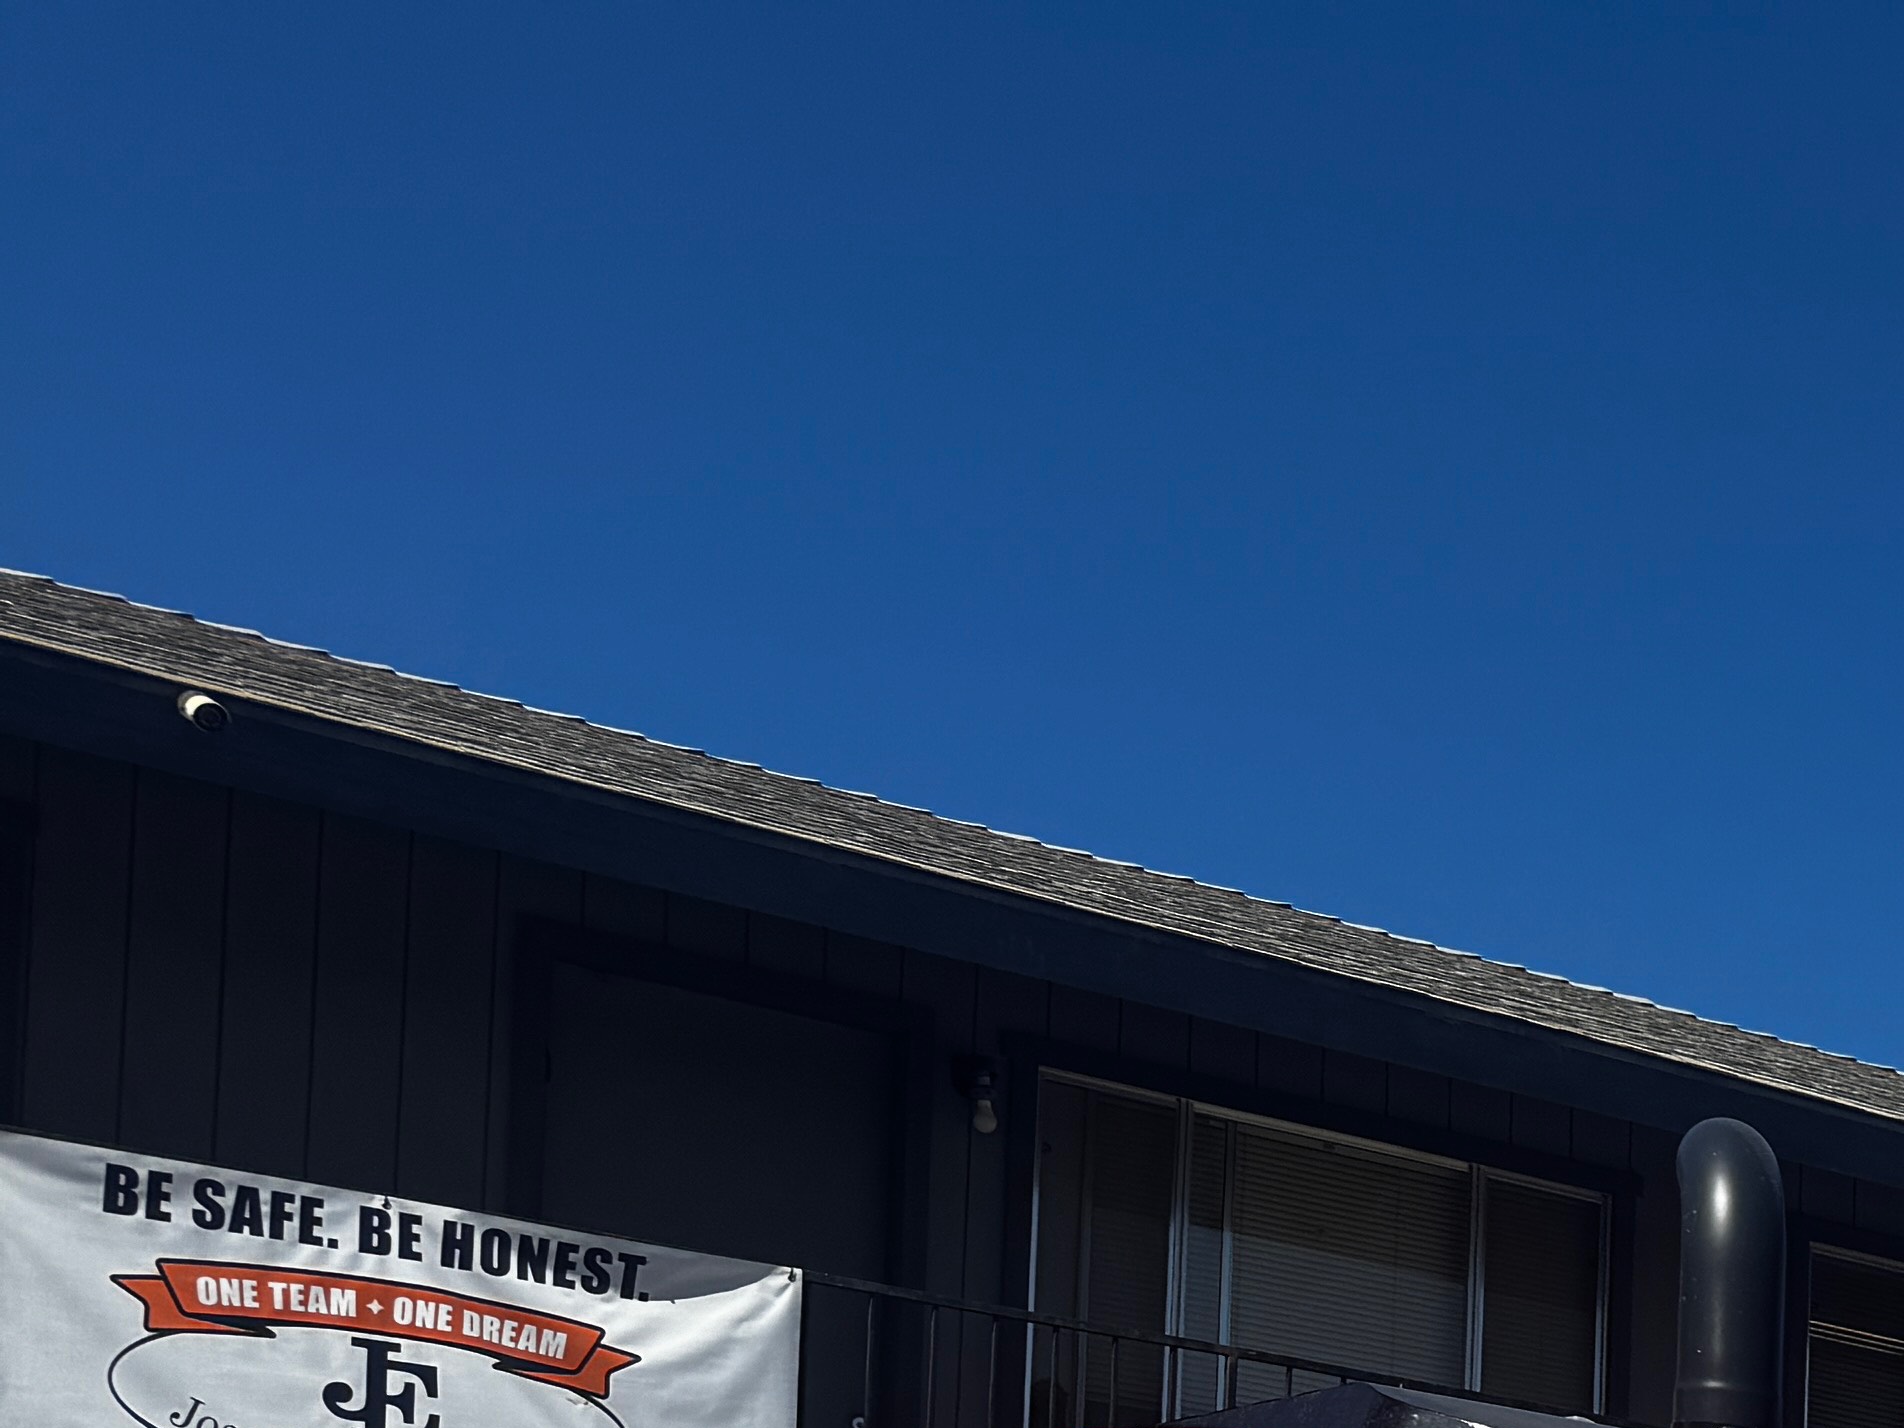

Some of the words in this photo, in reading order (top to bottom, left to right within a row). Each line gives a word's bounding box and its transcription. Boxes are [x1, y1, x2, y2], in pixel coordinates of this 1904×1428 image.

[102, 1162, 174, 1223] BE
[191, 1177, 339, 1249] SAFE.
[358, 1204, 423, 1263] BE
[439, 1218, 650, 1303] HONEST.
[195, 1275, 260, 1309] ONE
[267, 1280, 358, 1318] TEAM
[392, 1295, 454, 1333] ONE
[461, 1307, 568, 1361] DREAM
